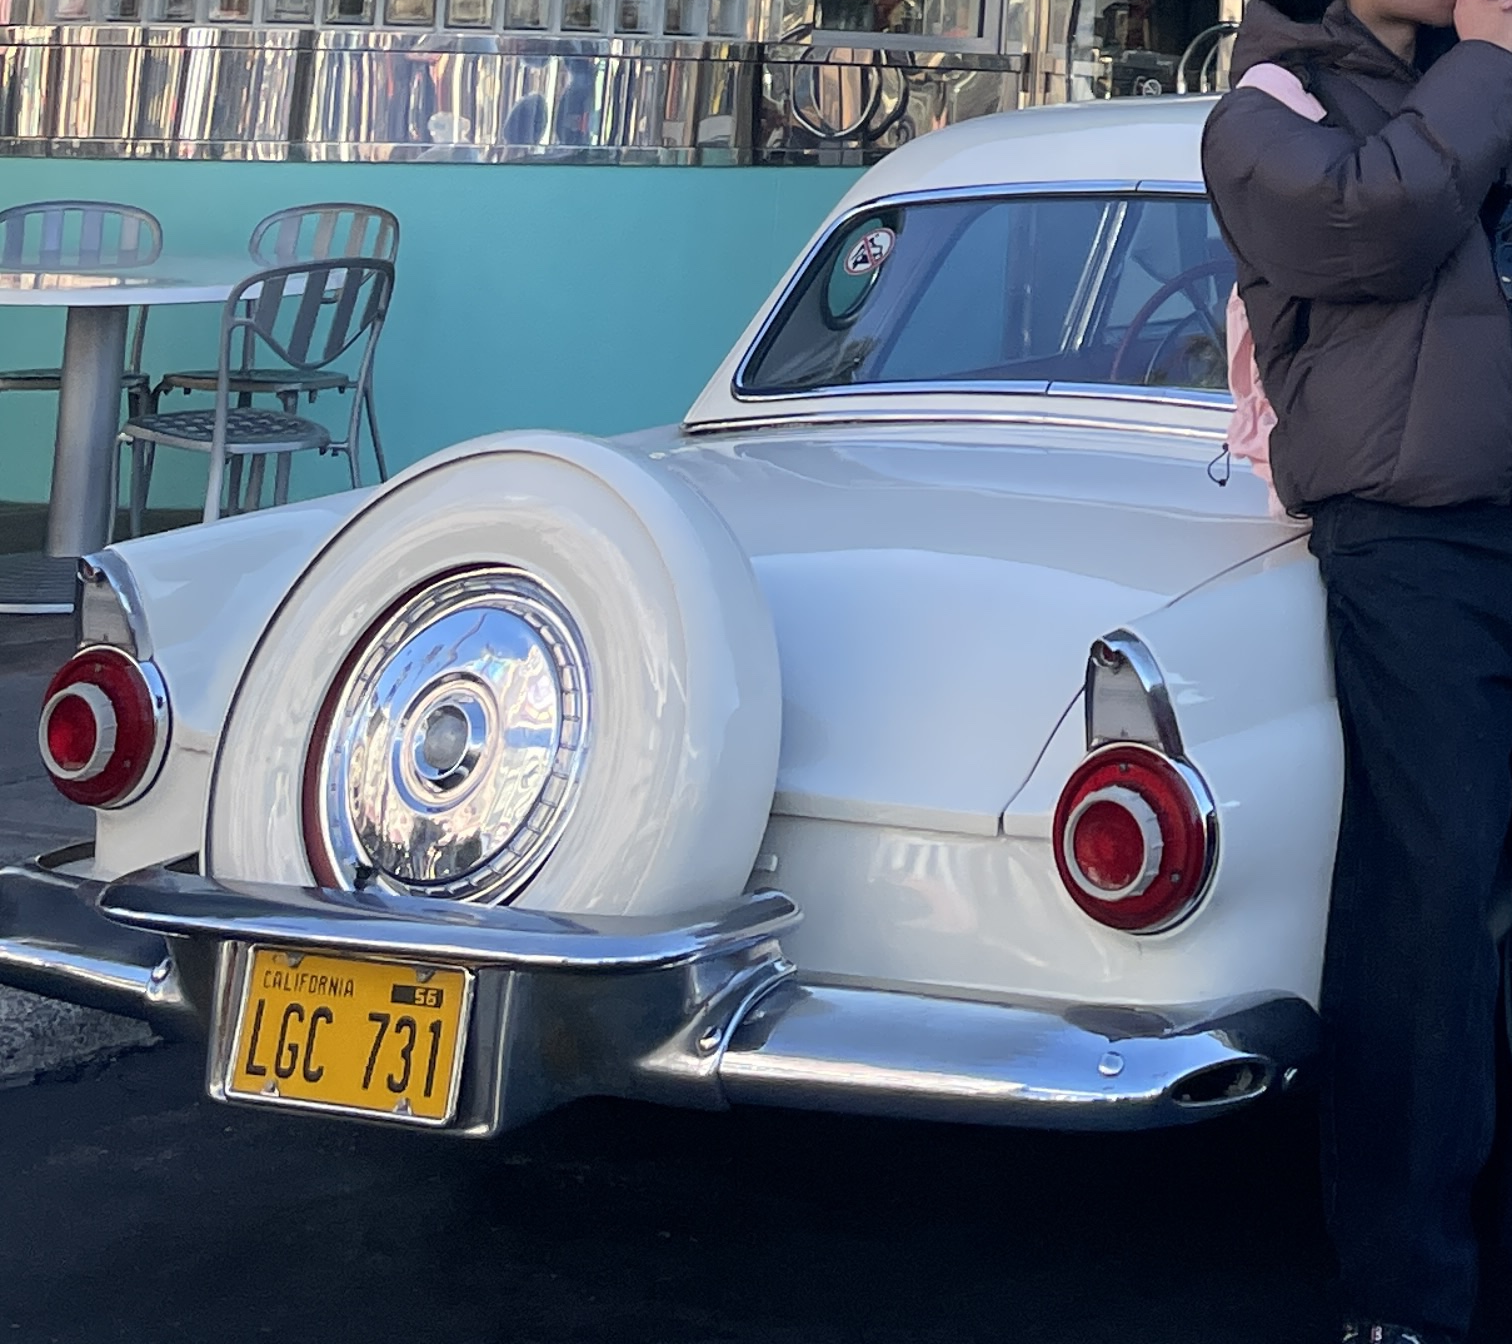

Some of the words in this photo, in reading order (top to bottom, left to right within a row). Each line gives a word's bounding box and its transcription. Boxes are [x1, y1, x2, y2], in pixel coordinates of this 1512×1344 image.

[263, 970, 355, 999] CALIFORNIA
[414, 987, 439, 1007] 56
[245, 998, 334, 1084] LGC
[361, 1012, 443, 1099] 731
